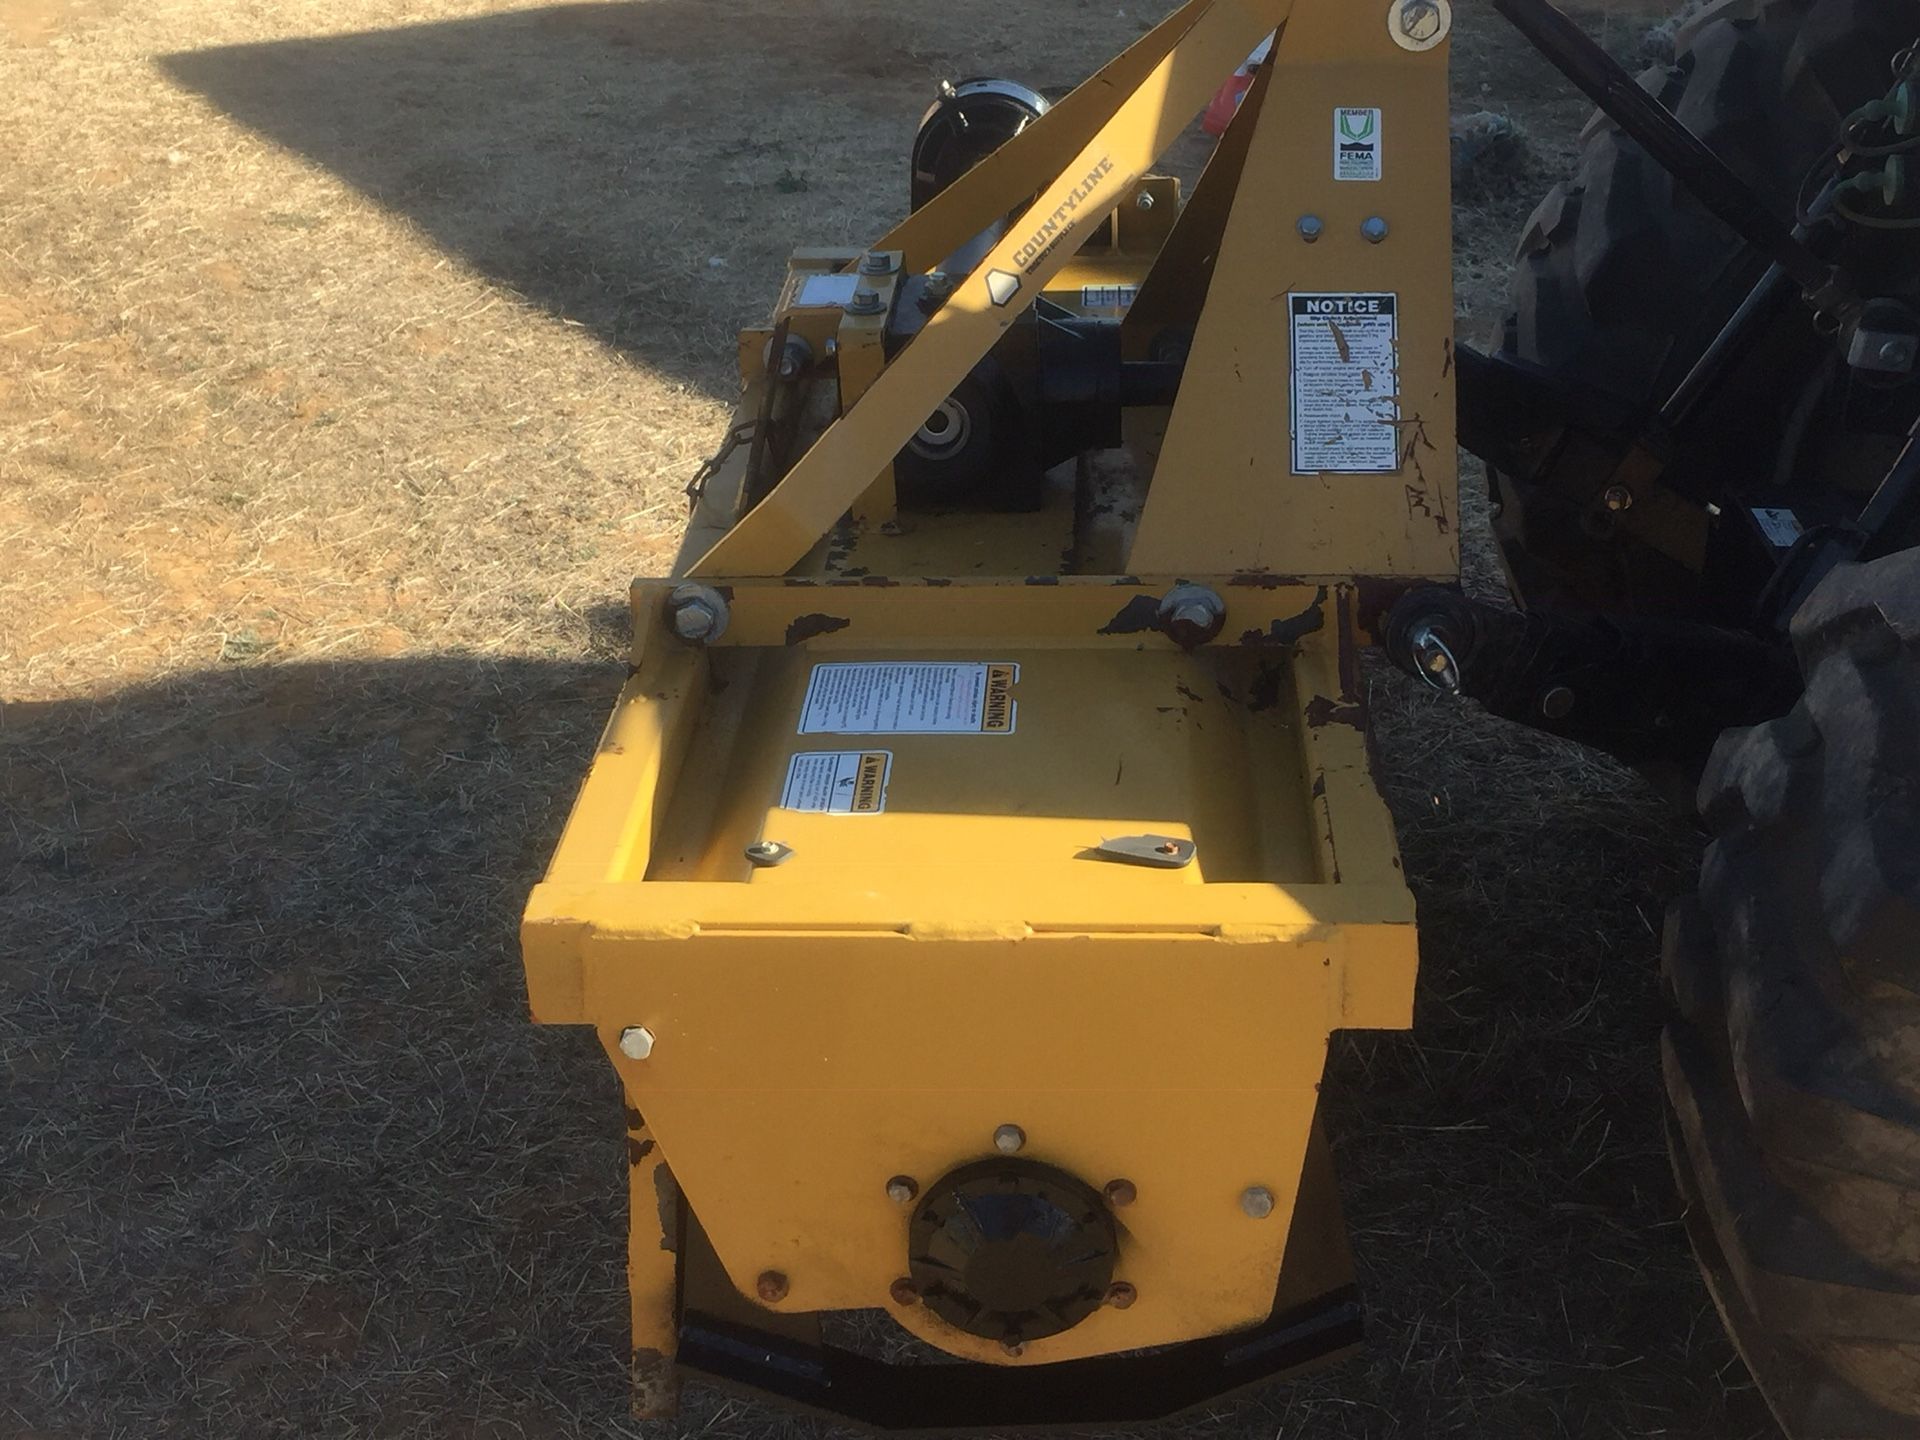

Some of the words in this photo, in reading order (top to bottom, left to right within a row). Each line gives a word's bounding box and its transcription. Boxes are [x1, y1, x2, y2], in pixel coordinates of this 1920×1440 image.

[1340, 151, 1374, 161] FEMA
[1012, 156, 1115, 268] COUNTYLINE
[1306, 300, 1379, 313] NOTICE
[987, 679, 1008, 728] WARNING
[857, 764, 878, 810] WARNING
